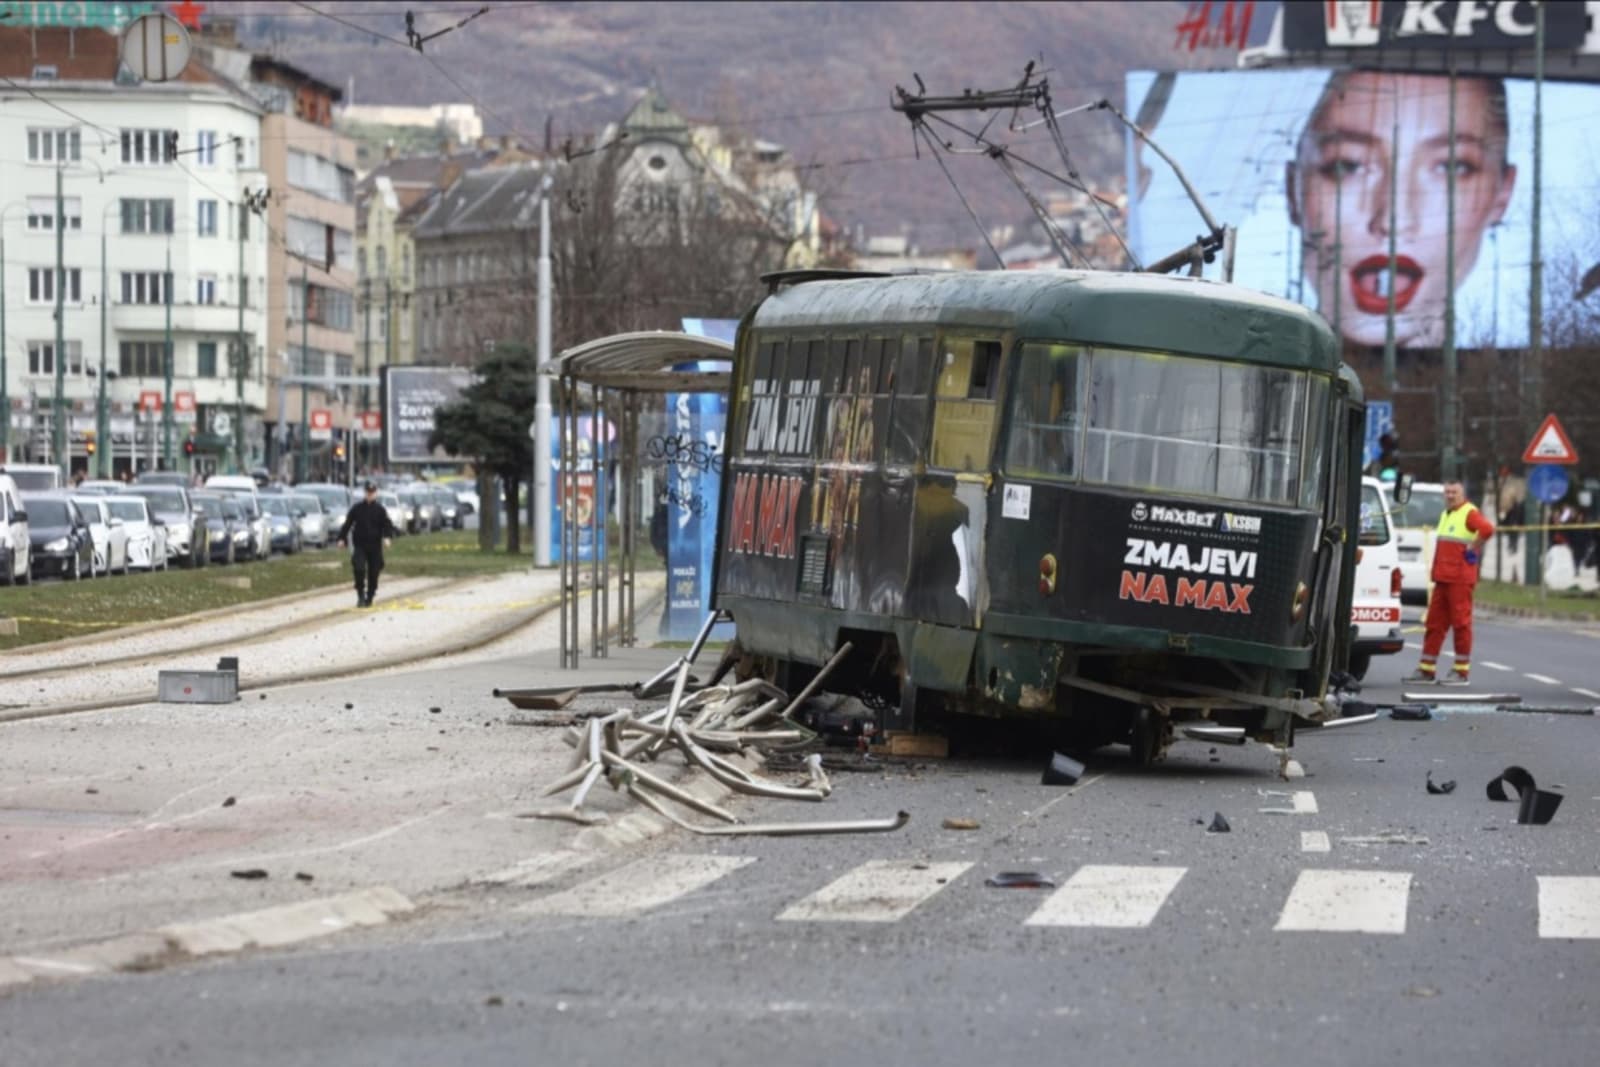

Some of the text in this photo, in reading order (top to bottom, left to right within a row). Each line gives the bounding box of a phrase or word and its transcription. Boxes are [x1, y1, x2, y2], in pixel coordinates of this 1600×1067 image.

[1396, 1, 1537, 36] KFC
[728, 472, 758, 554] NA
[754, 473, 803, 559] MAX
[1124, 538, 1258, 578] ZMAJEVI
[1119, 570, 1254, 614] NA MAX
